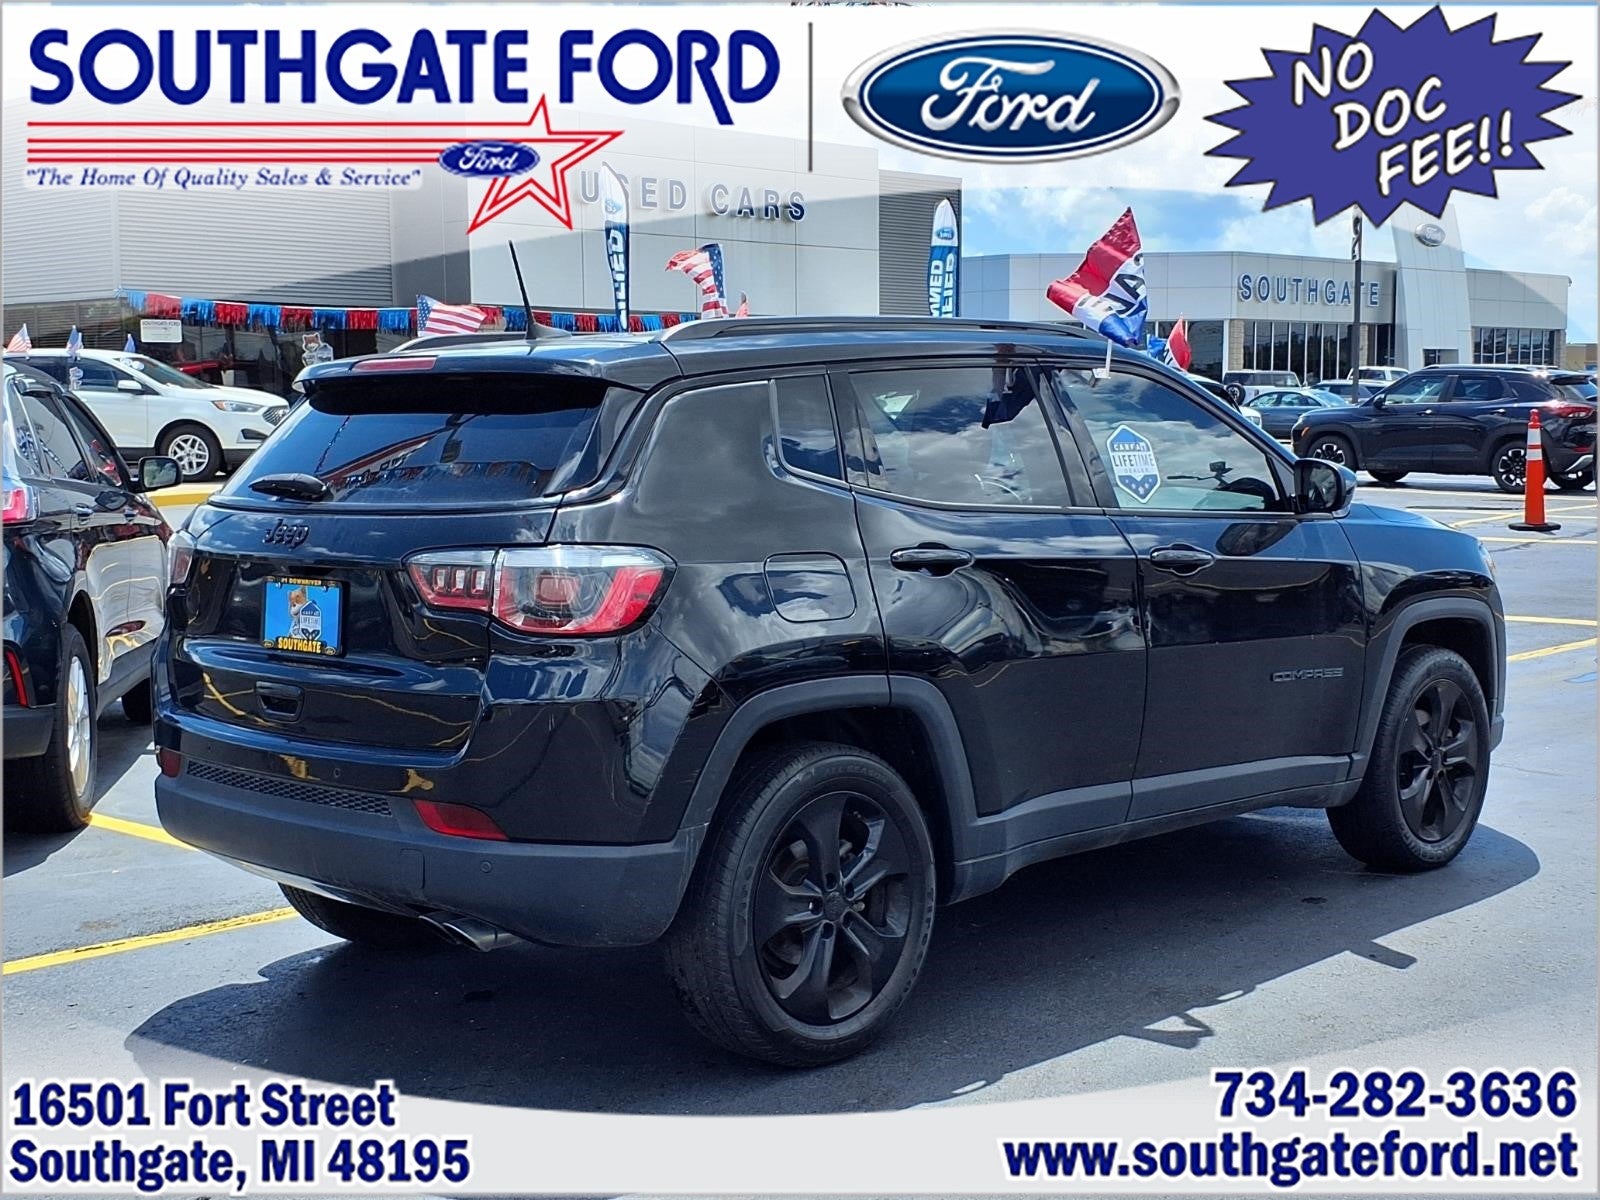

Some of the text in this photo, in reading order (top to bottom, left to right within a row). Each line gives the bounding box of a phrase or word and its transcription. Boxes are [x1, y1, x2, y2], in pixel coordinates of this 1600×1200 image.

[580, 170, 806, 221] UED CARS
[1240, 273, 1381, 307] SOUTHGAE
[1111, 453, 1156, 468] LIFETIME
[263, 518, 310, 551] Jeep
[277, 636, 322, 655] SOUTHGATE
[1271, 666, 1344, 682] COMPASS
